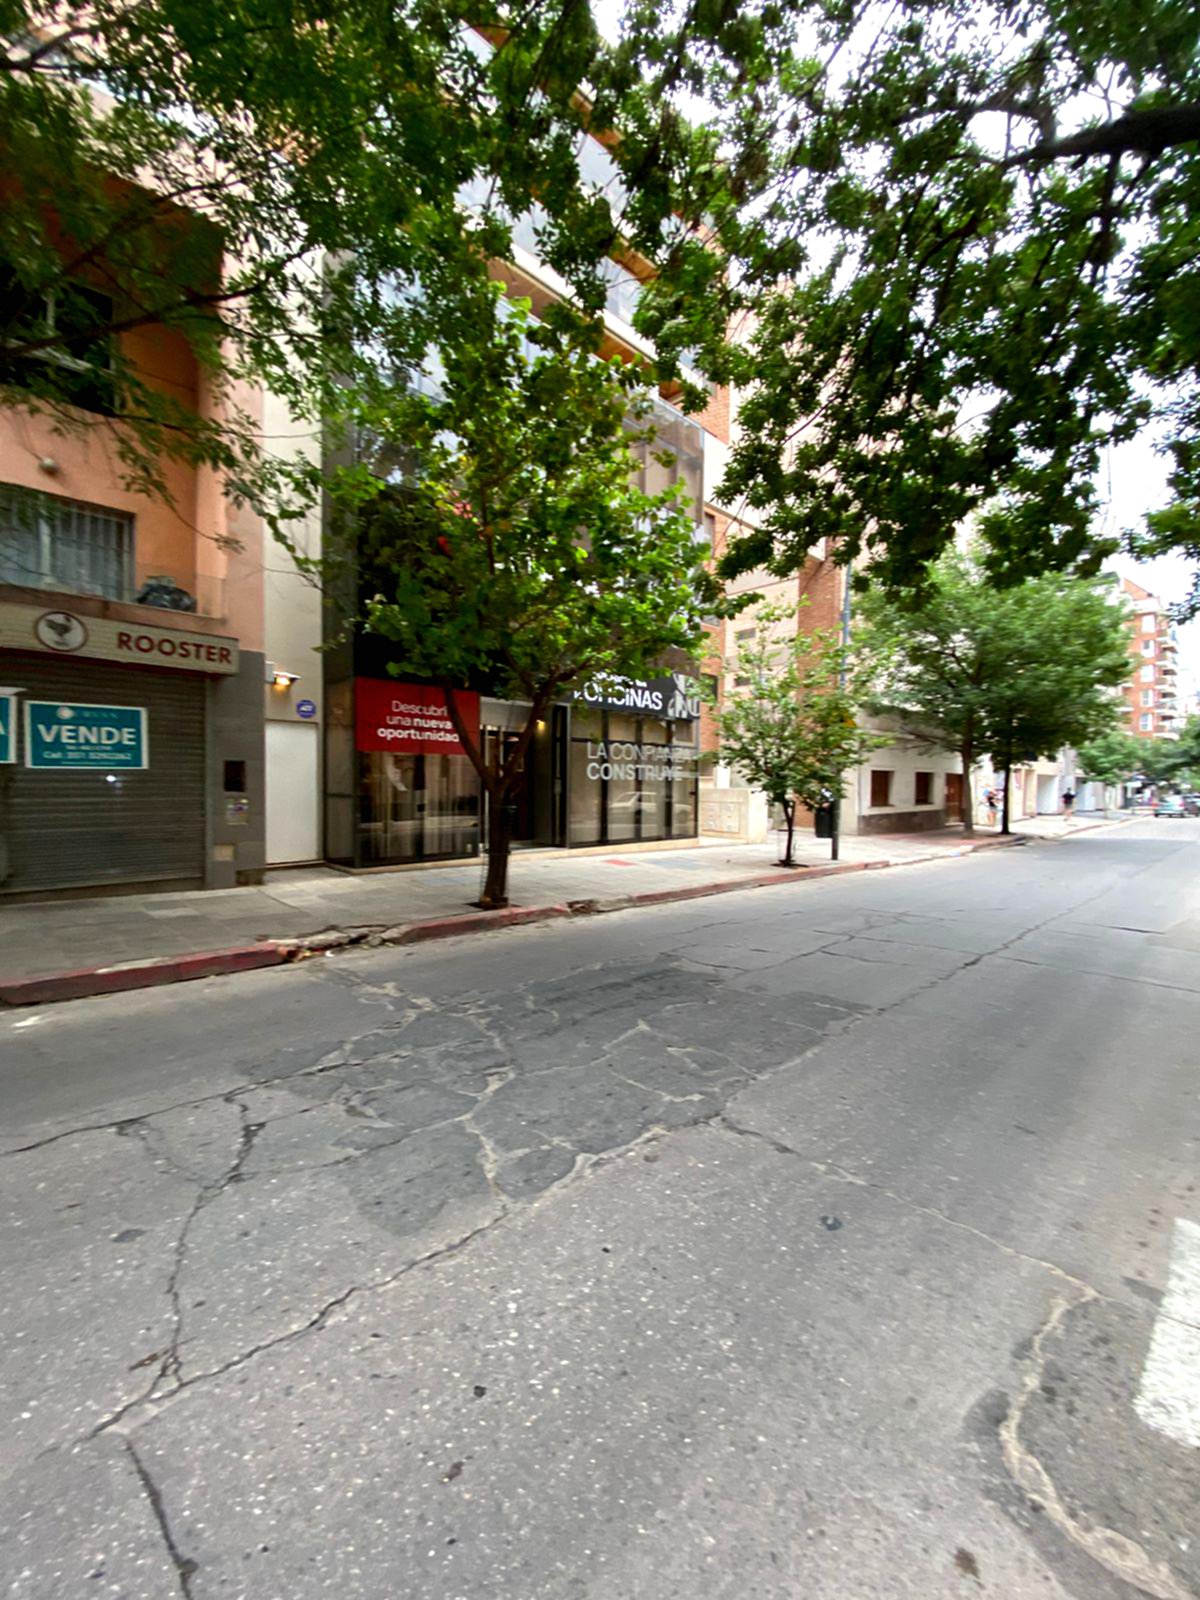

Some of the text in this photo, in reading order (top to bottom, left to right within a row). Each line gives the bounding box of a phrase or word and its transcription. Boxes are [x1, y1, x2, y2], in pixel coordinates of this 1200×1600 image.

[116, 631, 232, 664] ROOSTER
[386, 715, 453, 729] una nueva
[37, 724, 136, 745] VENDE
[587, 741, 607, 759] LA
[586, 762, 683, 781] CONSTRUYE
